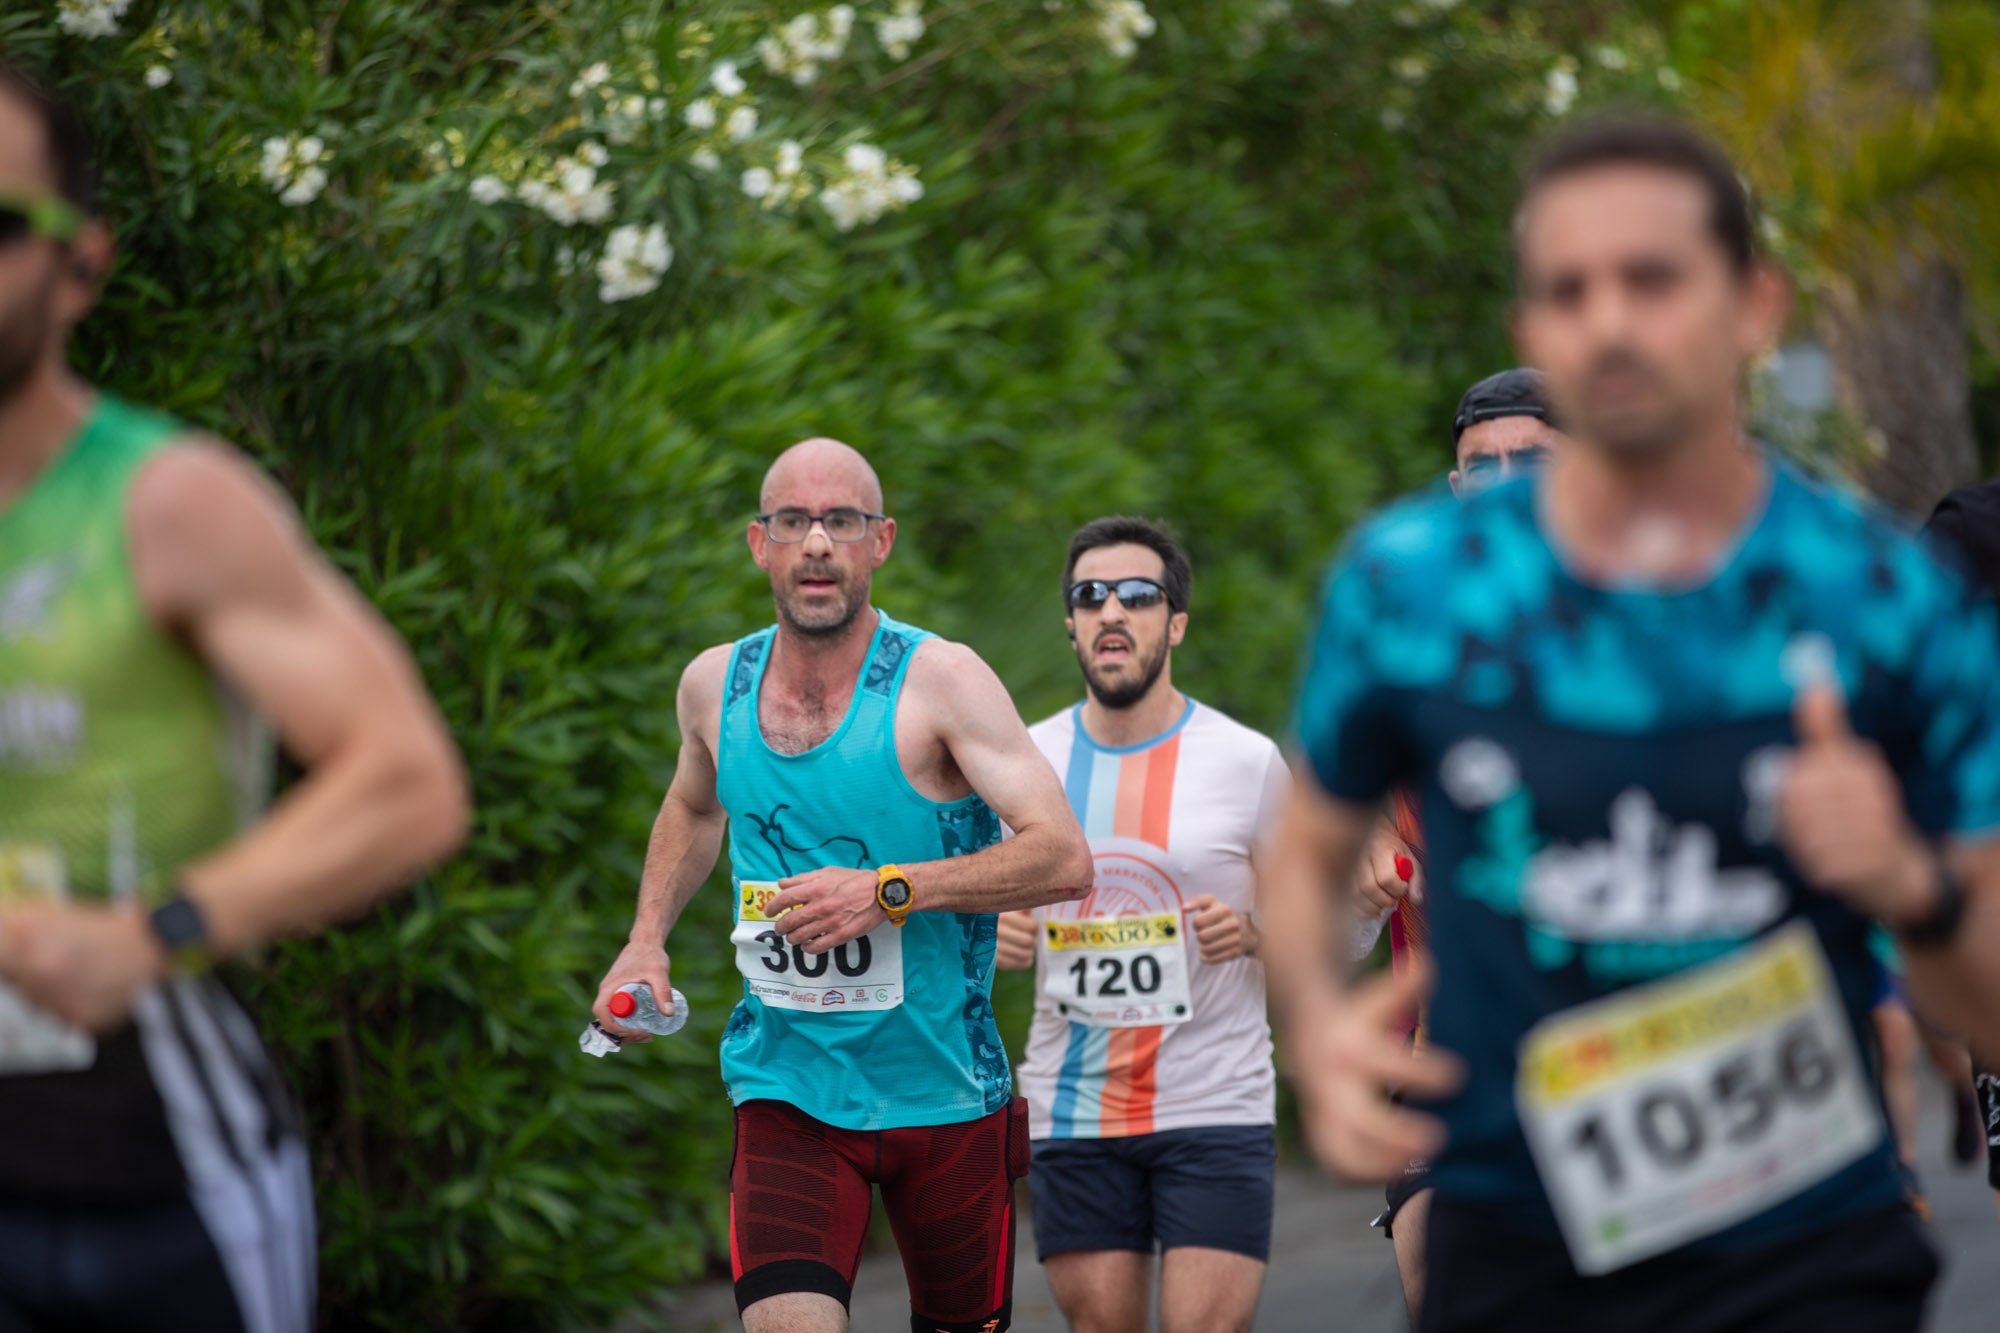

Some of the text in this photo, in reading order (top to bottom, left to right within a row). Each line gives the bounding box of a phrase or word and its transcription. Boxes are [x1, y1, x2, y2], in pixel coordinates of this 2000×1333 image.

[755, 929, 872, 978] 300
[1069, 954, 1161, 997] 120
[1568, 1015, 1839, 1191] 1056
